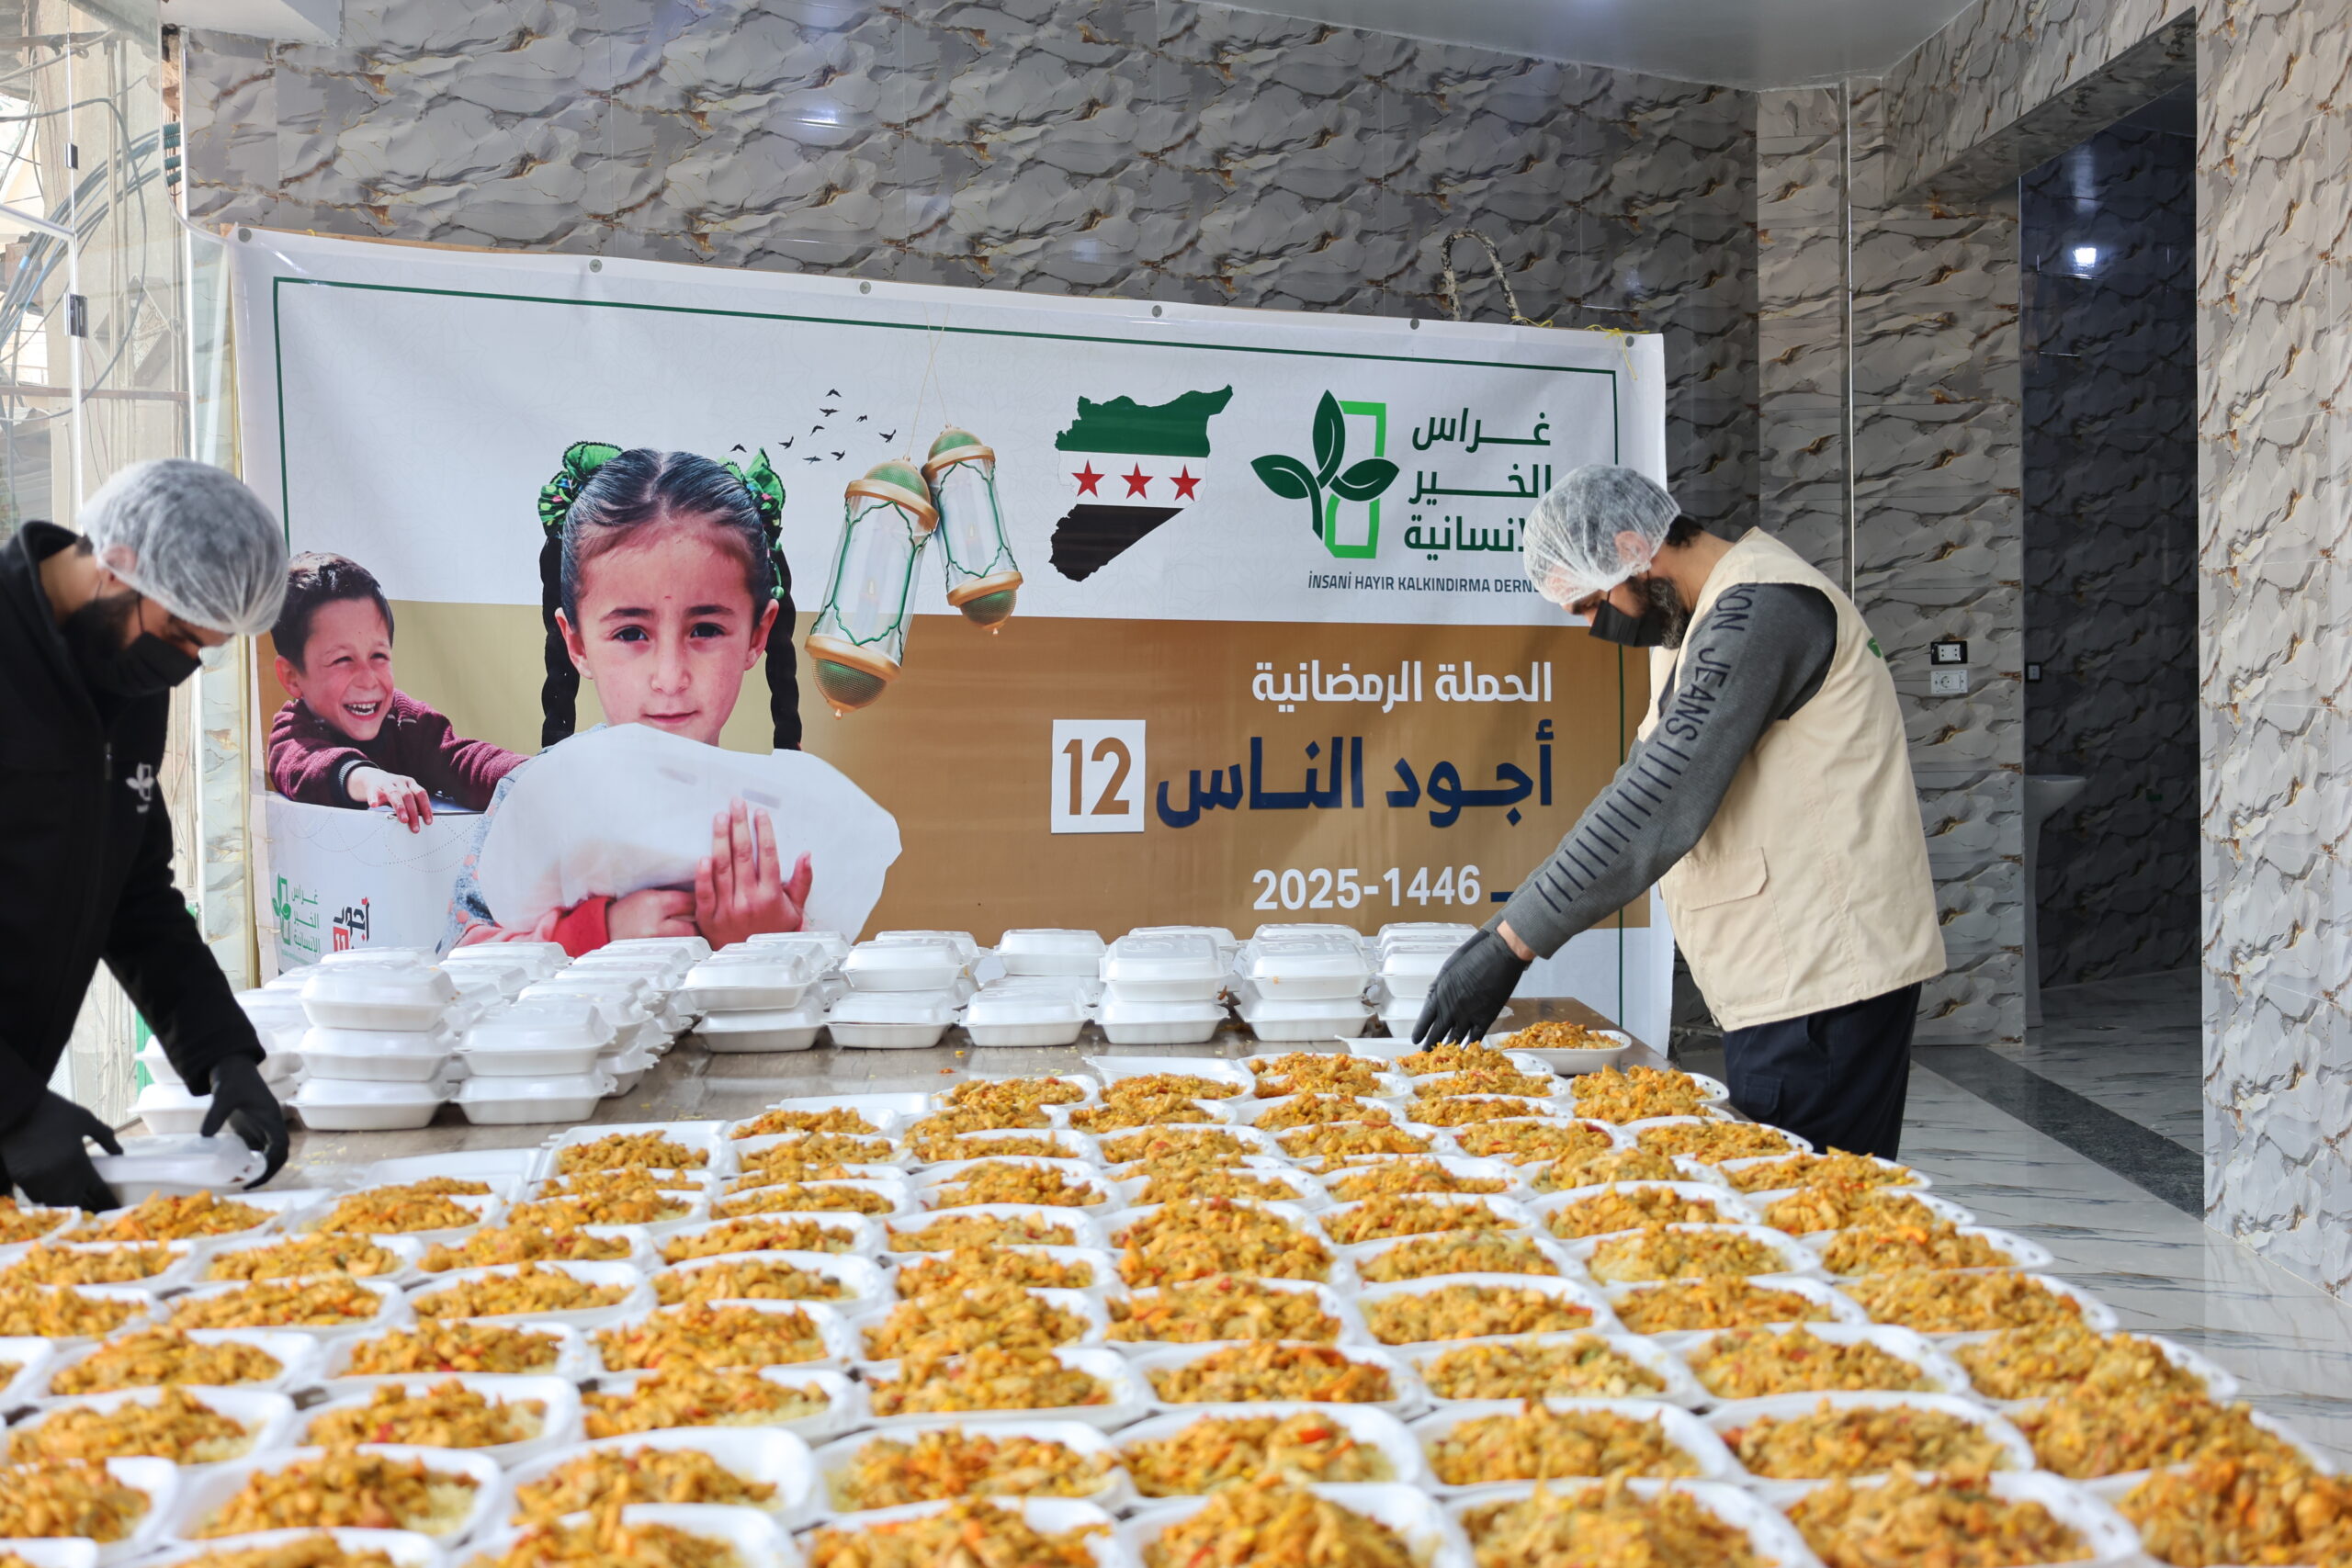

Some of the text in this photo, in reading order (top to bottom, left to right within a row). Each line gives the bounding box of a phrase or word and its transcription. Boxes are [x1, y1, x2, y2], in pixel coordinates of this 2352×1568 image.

[1411, 407, 1551, 453] غراس
[1408, 464, 1552, 506] الخير
[1404, 513, 1526, 561] نسانية
[1308, 570, 1351, 589] İNSANİ
[1355, 575, 1395, 590] HAYIR
[1398, 576, 1491, 592] KALKINDIRMA
[1251, 659, 1553, 713] الحملة الرمضانية
[1665, 648, 1732, 741] JEANS
[1062, 719, 1553, 829] أجود الناس 12
[1252, 864, 1481, 910] 2025-1446
